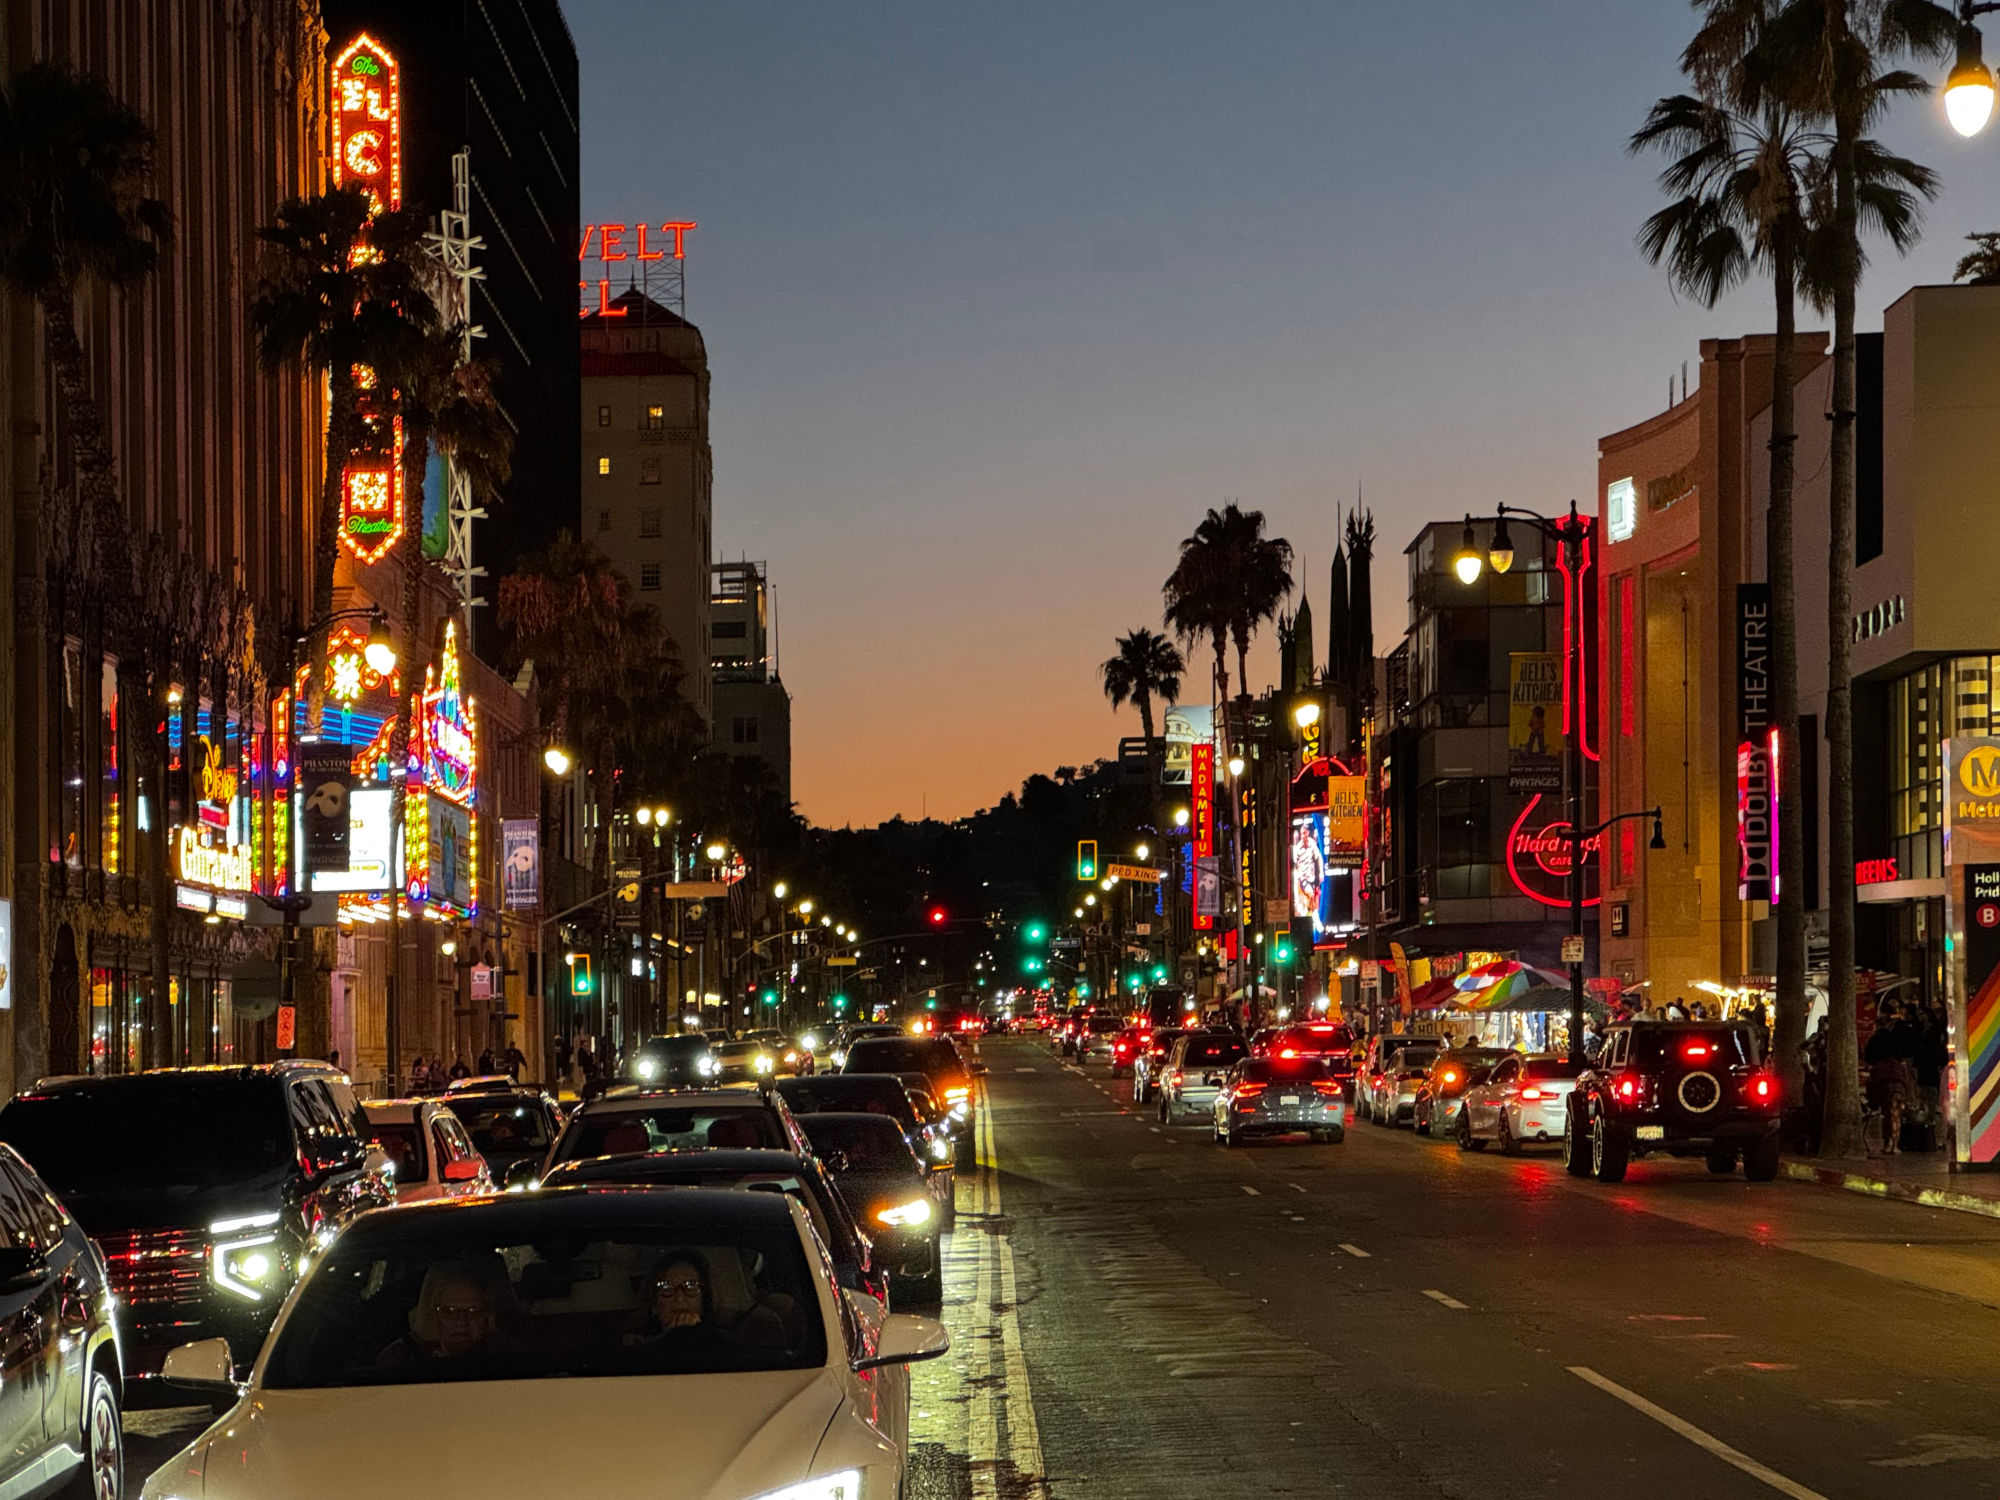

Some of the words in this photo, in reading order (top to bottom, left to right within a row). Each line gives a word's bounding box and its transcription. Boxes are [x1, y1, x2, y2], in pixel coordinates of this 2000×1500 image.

[351, 56, 380, 76] The
[338, 75, 391, 121] EL
[579, 278, 628, 316] L
[346, 515, 394, 534] Theatre
[1520, 662, 1558, 682] HELL'S
[1744, 602, 1767, 733] THEATRE
[1512, 682, 1563, 703] KITCHEN
[303, 758, 350, 769] PHANTOM
[1197, 748, 1208, 822] MADAME
[1509, 777, 1560, 787] PANTAGES
[1745, 742, 1768, 836] DOLBY
[1335, 791, 1359, 805] HELL'S
[1330, 804, 1363, 818] KITCHEN
[1516, 834, 1560, 853] Hard
[1111, 866, 1131, 877] PED
[1135, 869, 1157, 881] XING
[1982, 908, 1995, 924] B
